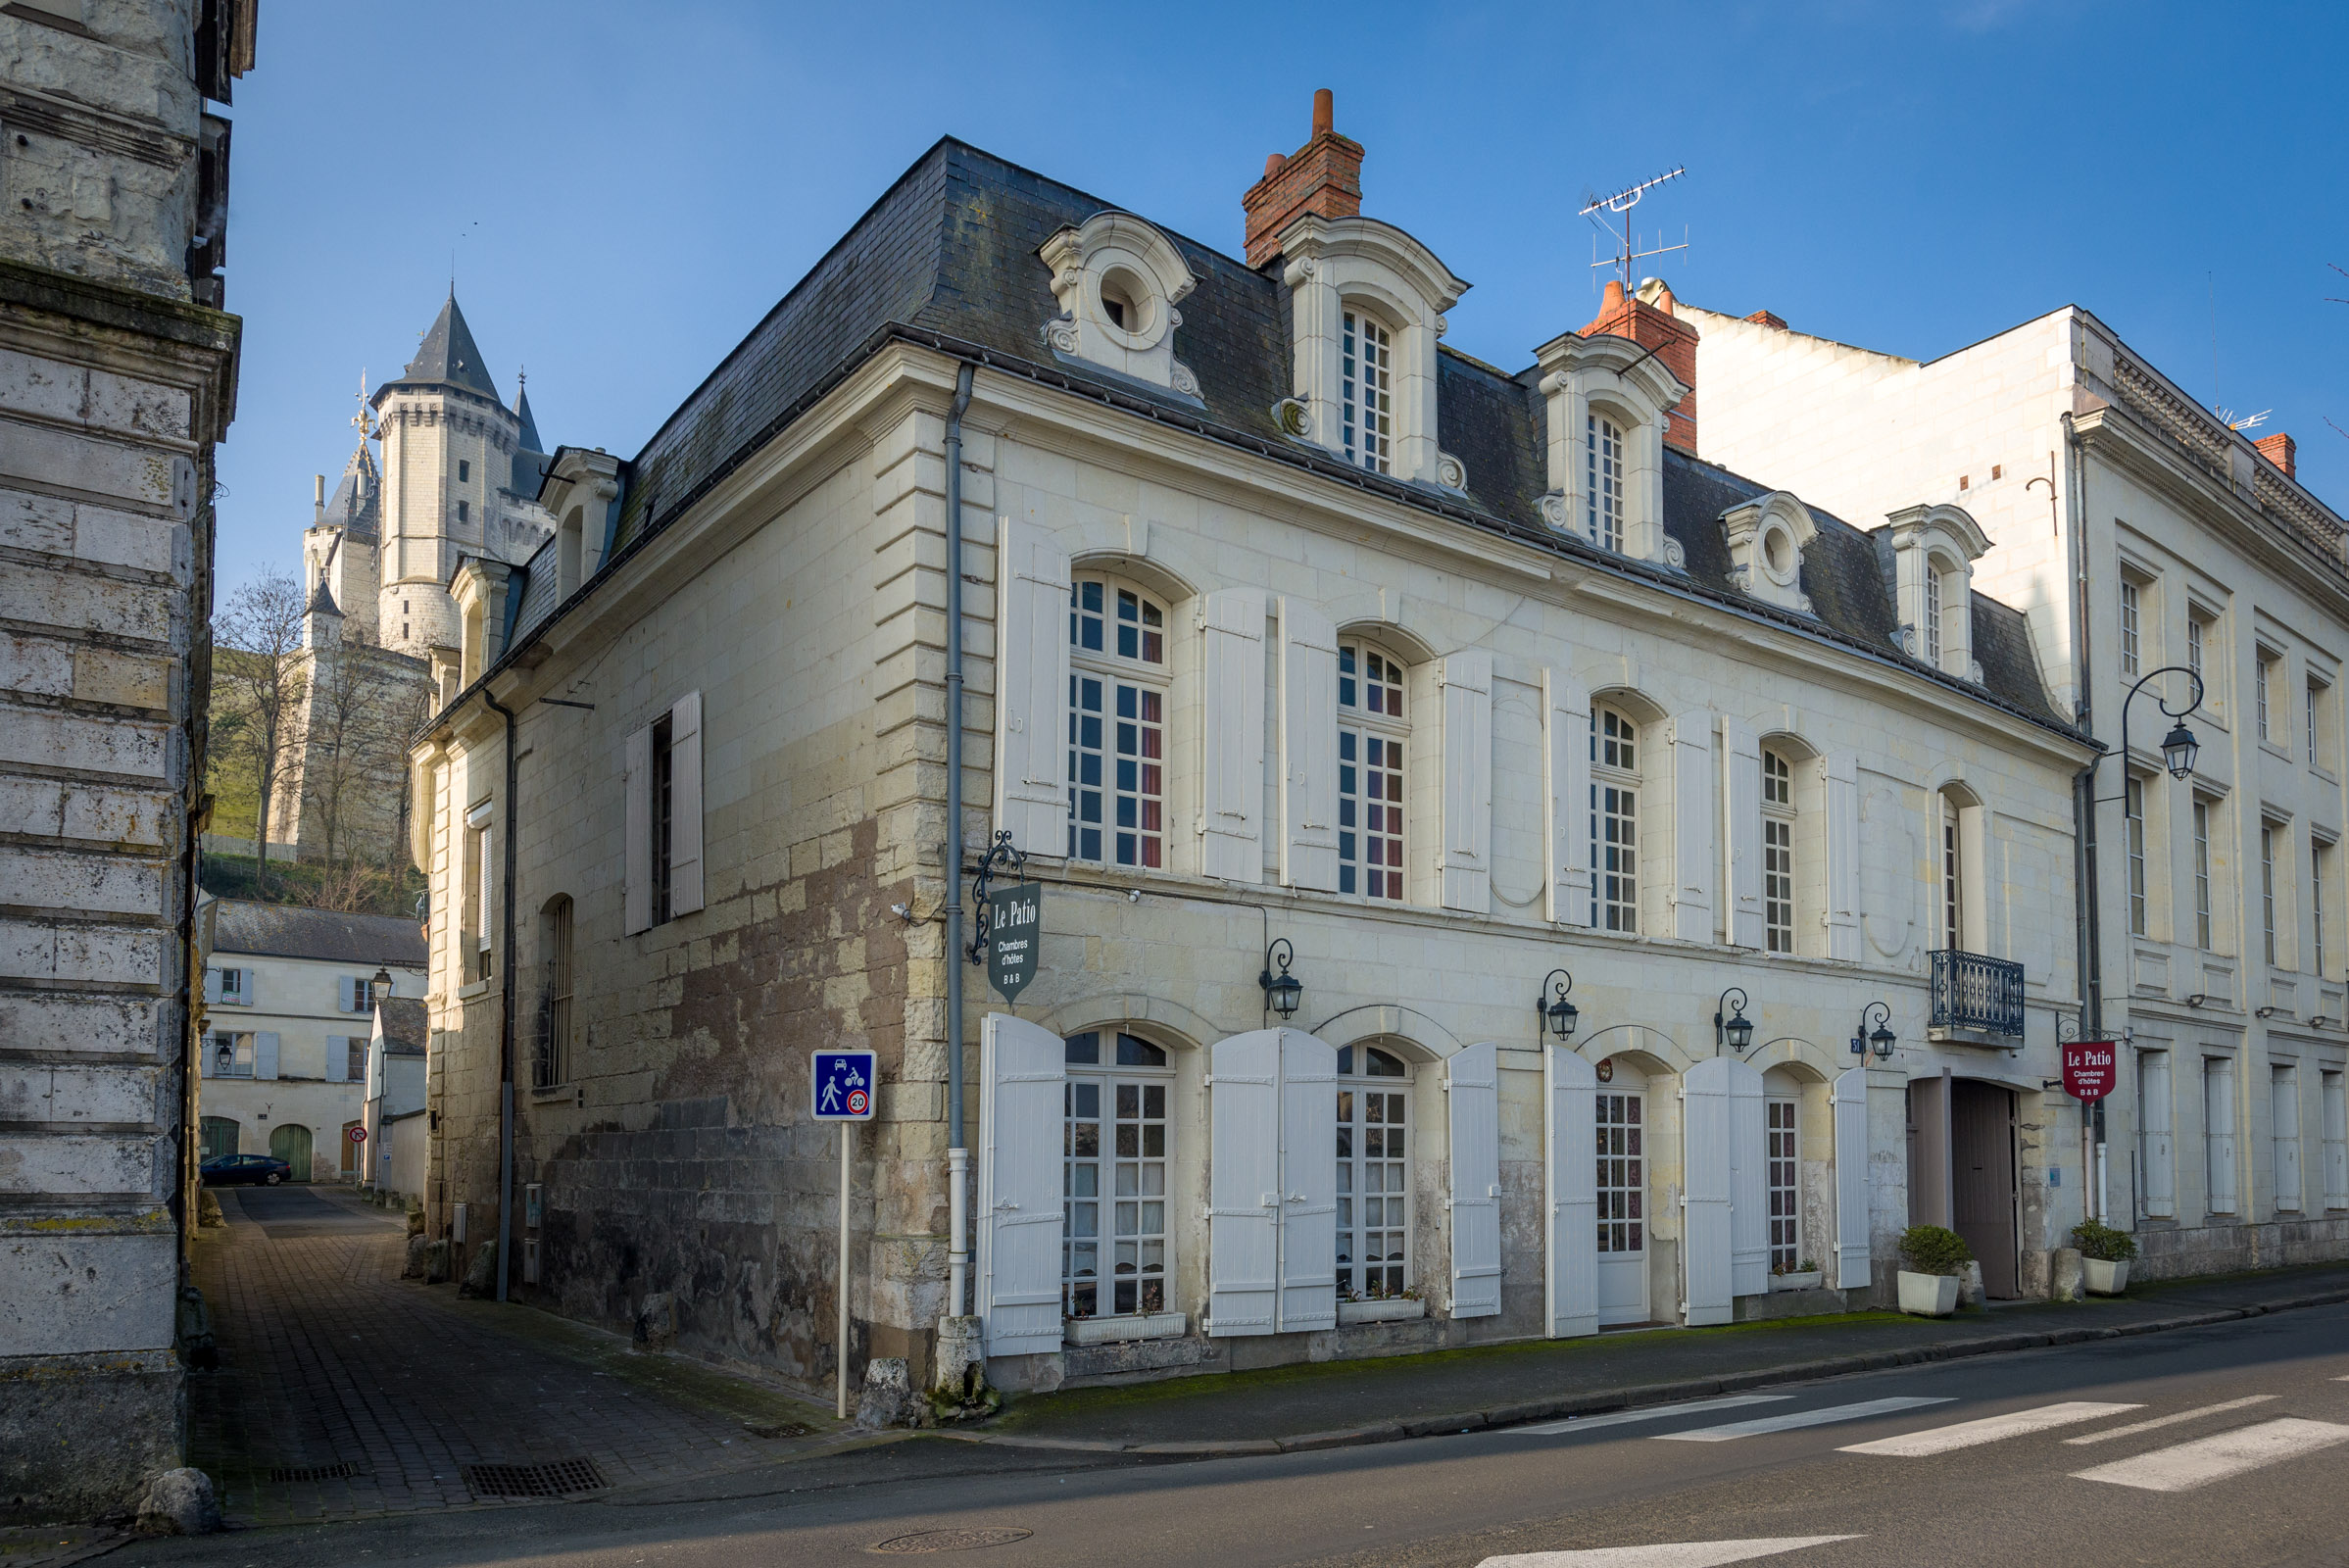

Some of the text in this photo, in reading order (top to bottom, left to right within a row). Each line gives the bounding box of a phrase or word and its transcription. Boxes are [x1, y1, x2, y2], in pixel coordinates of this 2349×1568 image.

[994, 898, 1036, 930] Le Patio
[998, 939, 1028, 953] Chambres
[1002, 954, 1024, 966] d'hôtes
[1003, 973, 1020, 985] B & B
[2068, 1051, 2111, 1067] Le Patio
[852, 1098, 864, 1107] 20
